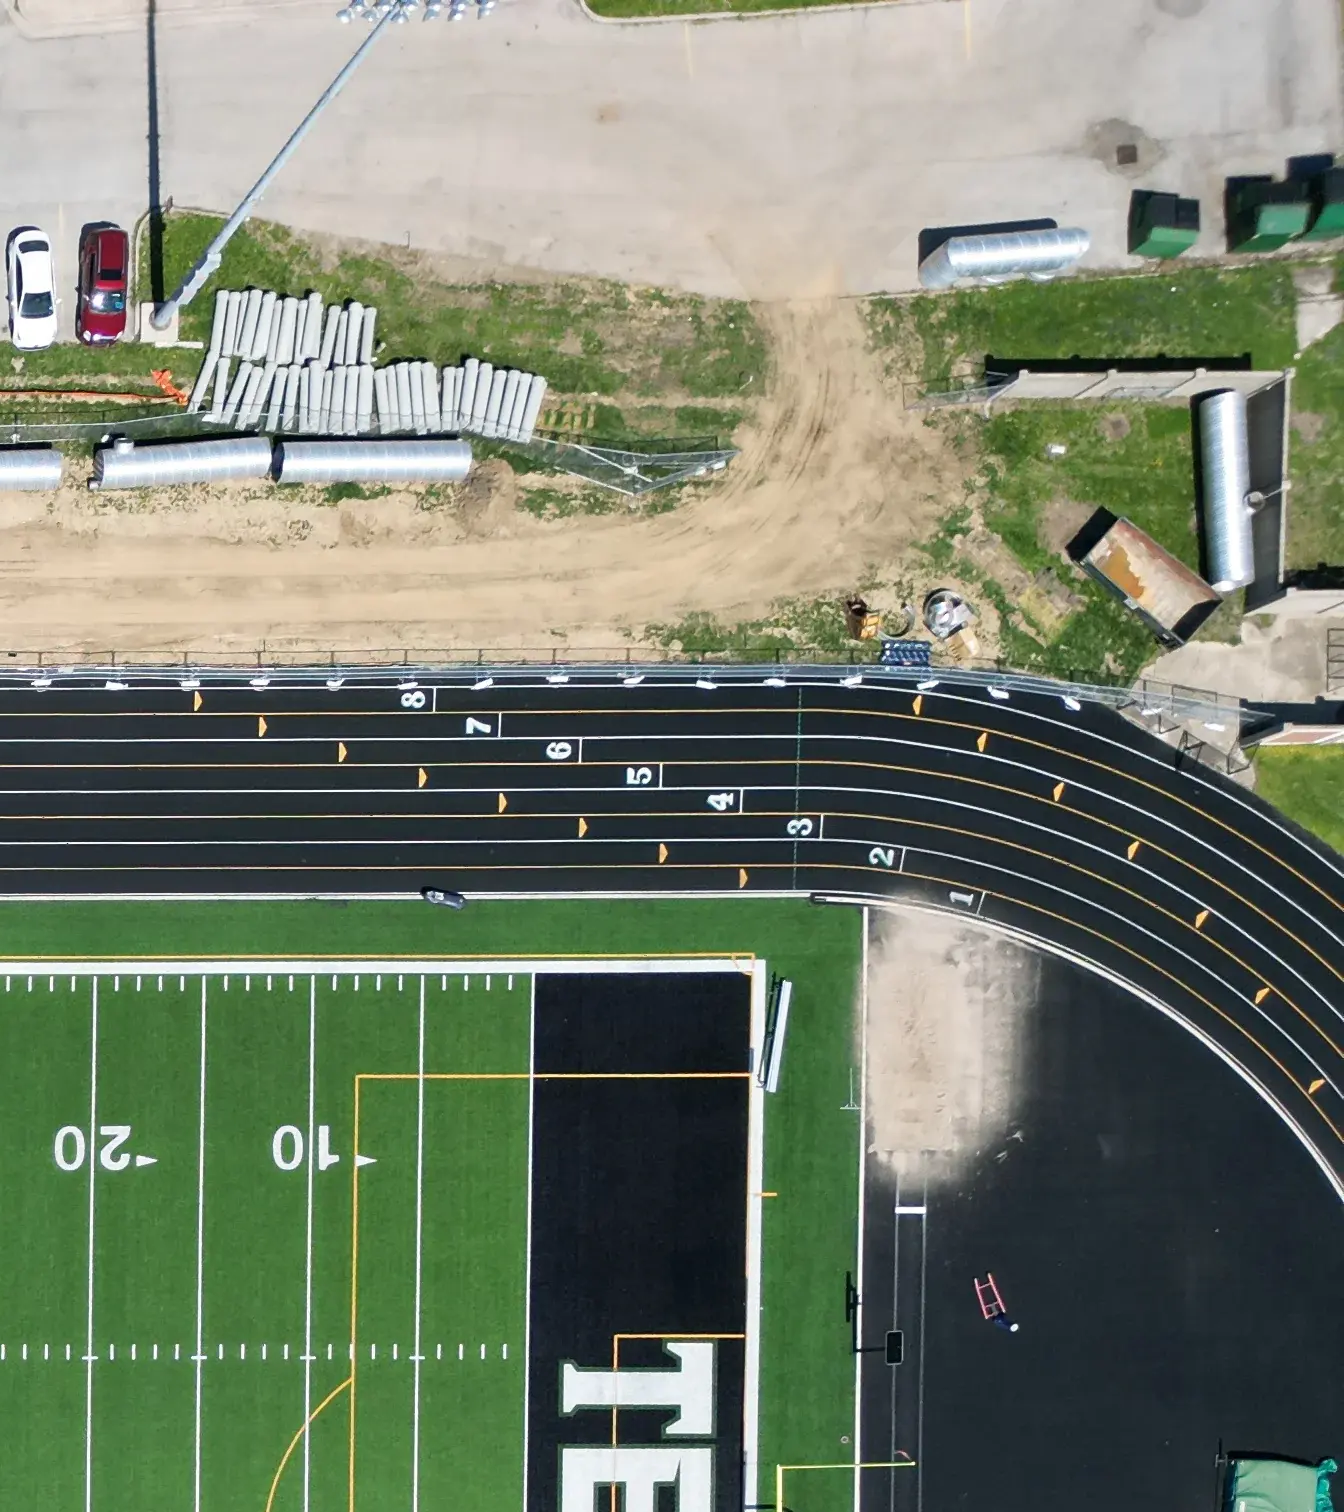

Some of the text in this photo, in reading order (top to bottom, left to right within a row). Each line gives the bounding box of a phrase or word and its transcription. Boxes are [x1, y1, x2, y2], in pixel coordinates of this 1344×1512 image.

[400, 690, 426, 709] 8
[465, 716, 492, 735] 7
[545, 741, 572, 760] 6
[626, 766, 653, 785] 5
[706, 792, 735, 812] 4
[786, 817, 814, 837] 3
[868, 846, 896, 867] 2
[948, 891, 975, 907] 1
[54, 1125, 132, 1171] 20
[272, 1125, 340, 1171] 10
